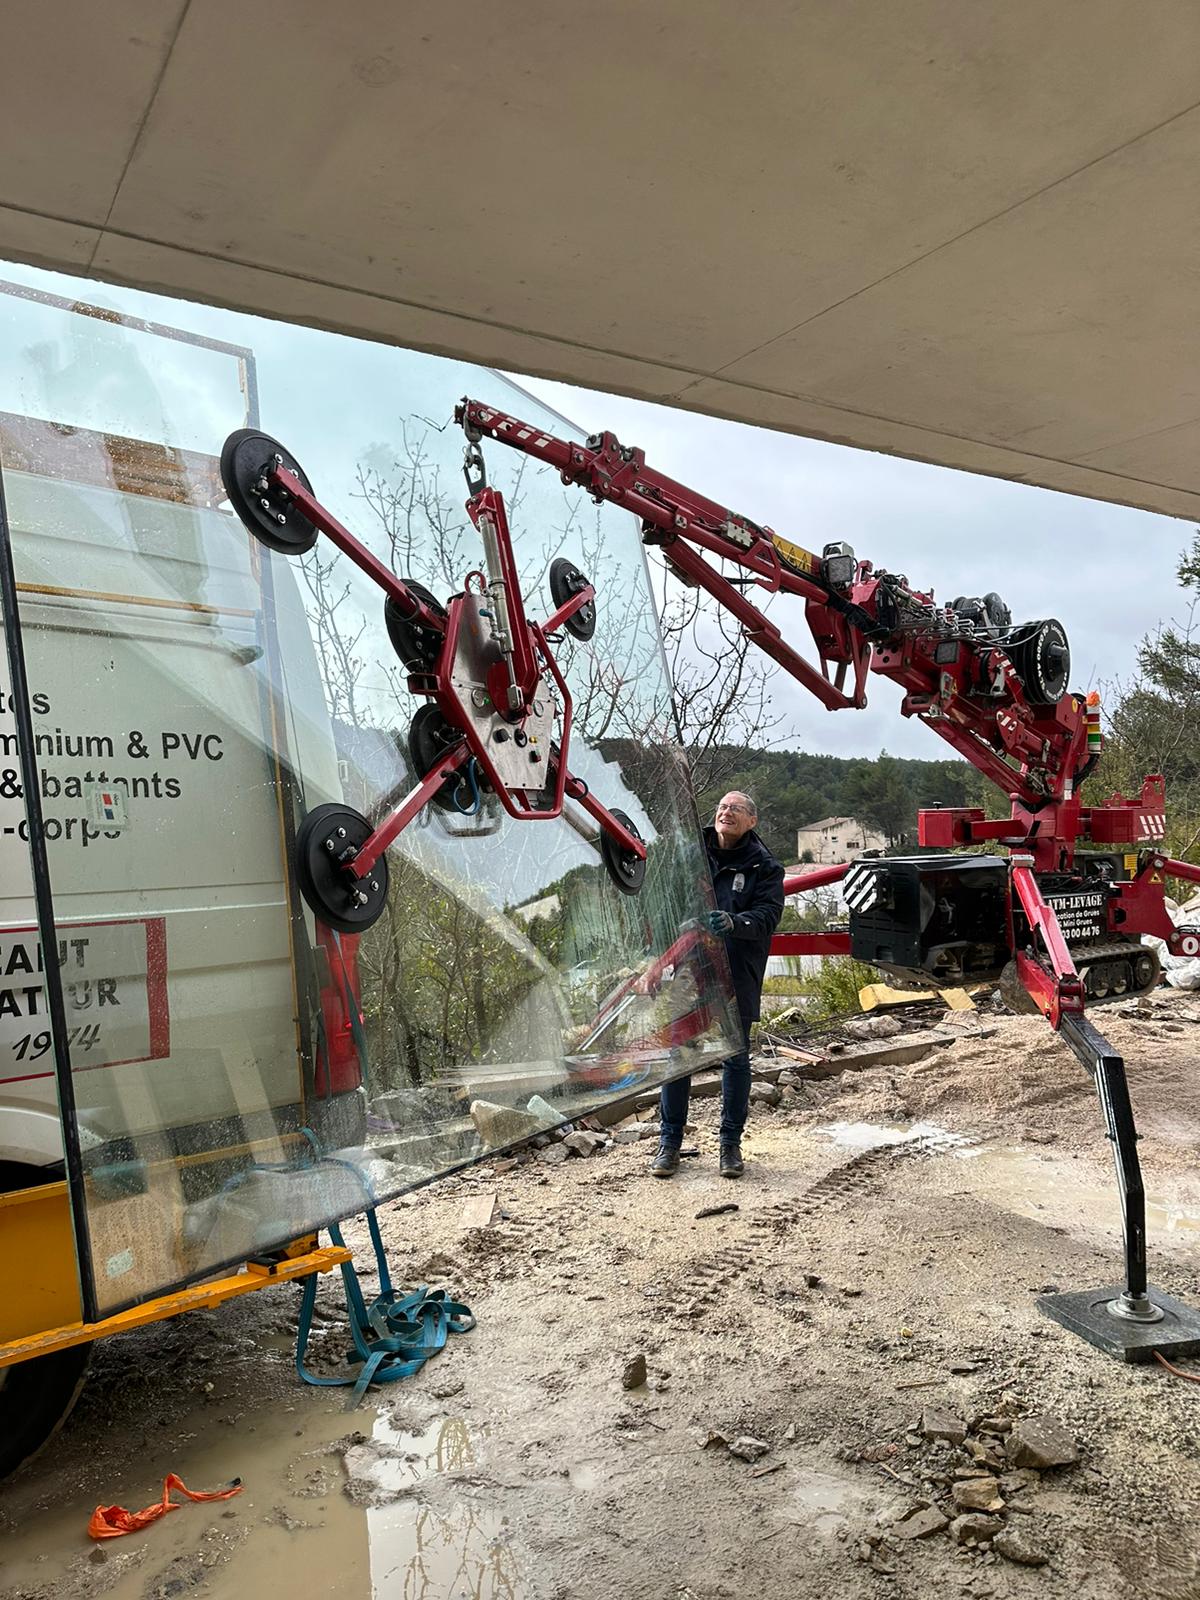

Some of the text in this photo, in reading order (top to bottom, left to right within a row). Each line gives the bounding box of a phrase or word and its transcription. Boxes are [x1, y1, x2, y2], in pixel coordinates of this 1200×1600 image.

[127, 730, 150, 759] &
[161, 732, 224, 761] PVC
[0, 768, 24, 799] &
[1070, 928, 1081, 938] 00
[1081, 926, 1091, 937] 44
[1091, 925, 1100, 936] 76
